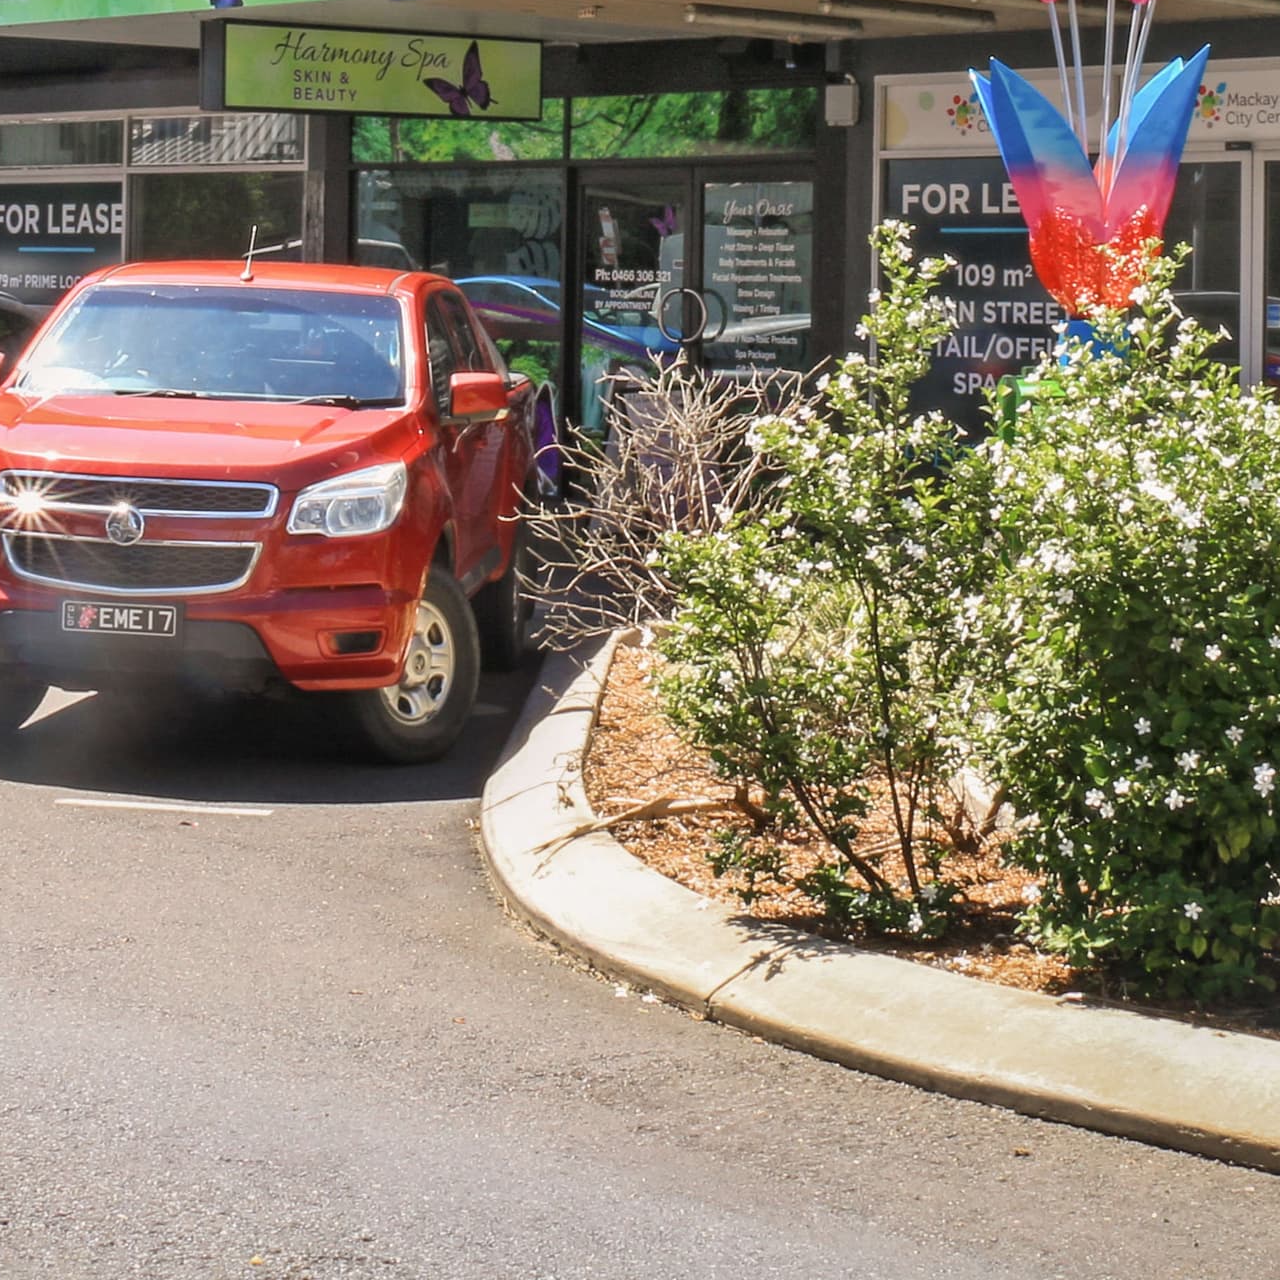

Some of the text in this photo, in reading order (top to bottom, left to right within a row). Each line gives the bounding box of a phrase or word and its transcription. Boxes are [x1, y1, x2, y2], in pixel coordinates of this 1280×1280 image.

[271, 31, 449, 82] Harmony Spa
[293, 69, 349, 84] SKIN &
[293, 87, 358, 102] BEAUTY
[1226, 91, 1279, 111] Mackay
[1225, 108, 1250, 128] City
[902, 183, 970, 215] FOR
[47, 203, 123, 234] LEASE
[723, 198, 793, 224] Your Oasis
[24, 274, 57, 288] PRIME
[59, 275, 81, 288] LOC
[956, 264, 995, 287] 109
[983, 300, 1070, 324] STREE
